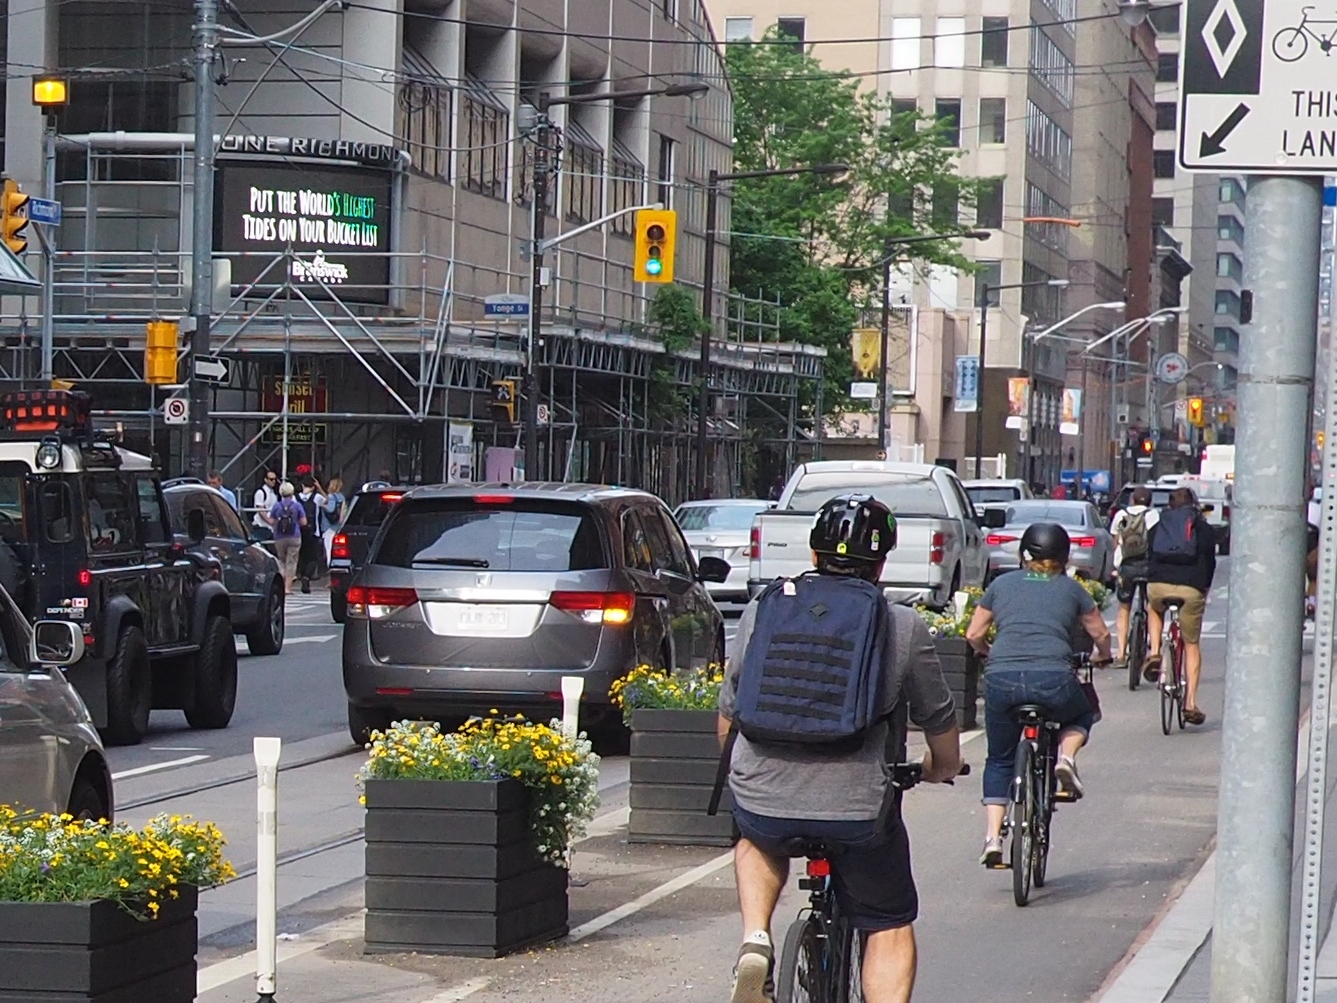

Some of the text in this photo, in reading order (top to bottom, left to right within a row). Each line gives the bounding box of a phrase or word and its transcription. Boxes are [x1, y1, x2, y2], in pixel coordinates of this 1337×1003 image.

[221, 135, 285, 152] ONE
[250, 186, 375, 219] PUT THE WORLD'S HIGHEST
[242, 214, 378, 247] TIDES ON YOUR BUCKET LIST
